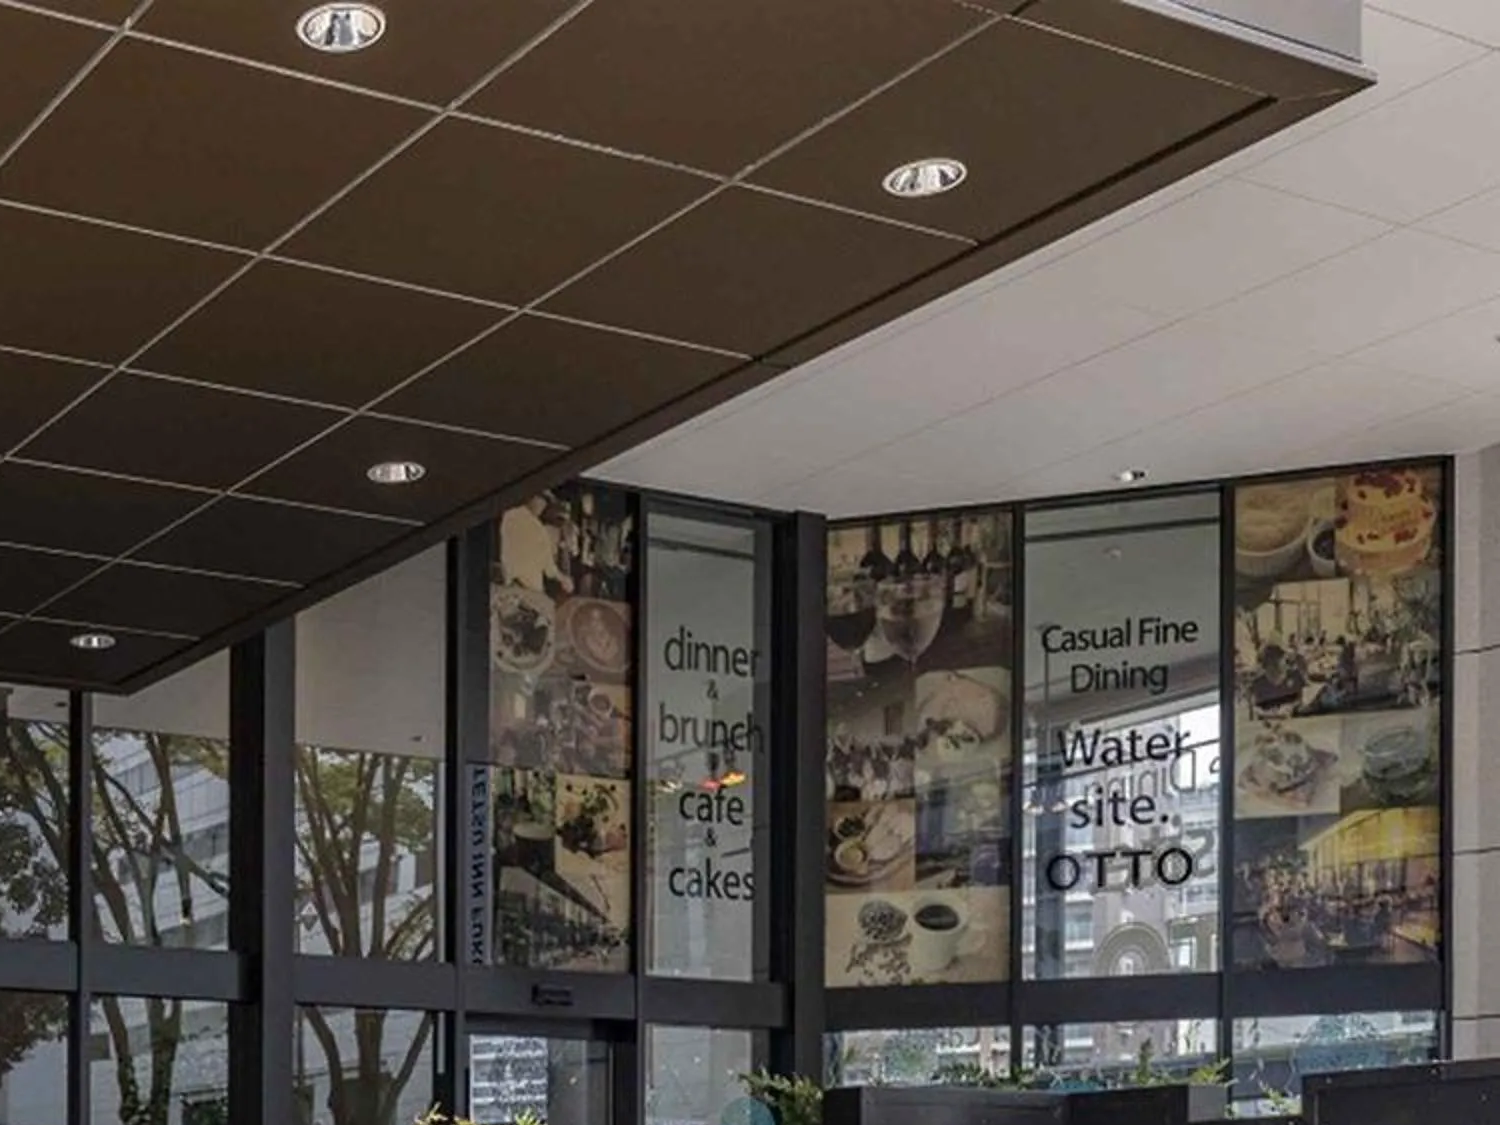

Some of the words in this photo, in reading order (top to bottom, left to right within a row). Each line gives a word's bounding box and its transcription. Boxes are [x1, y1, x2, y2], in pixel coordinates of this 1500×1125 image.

[663, 625, 762, 678] dinner
[1041, 618, 1131, 654] Casual
[1138, 616, 1199, 646] Fine
[1070, 660, 1170, 694] Dining
[658, 701, 765, 754] brunch
[1056, 728, 1192, 768] Water
[1069, 786, 1170, 829] site.
[668, 857, 757, 901] cakes
[1045, 847, 1193, 891] OTTO
